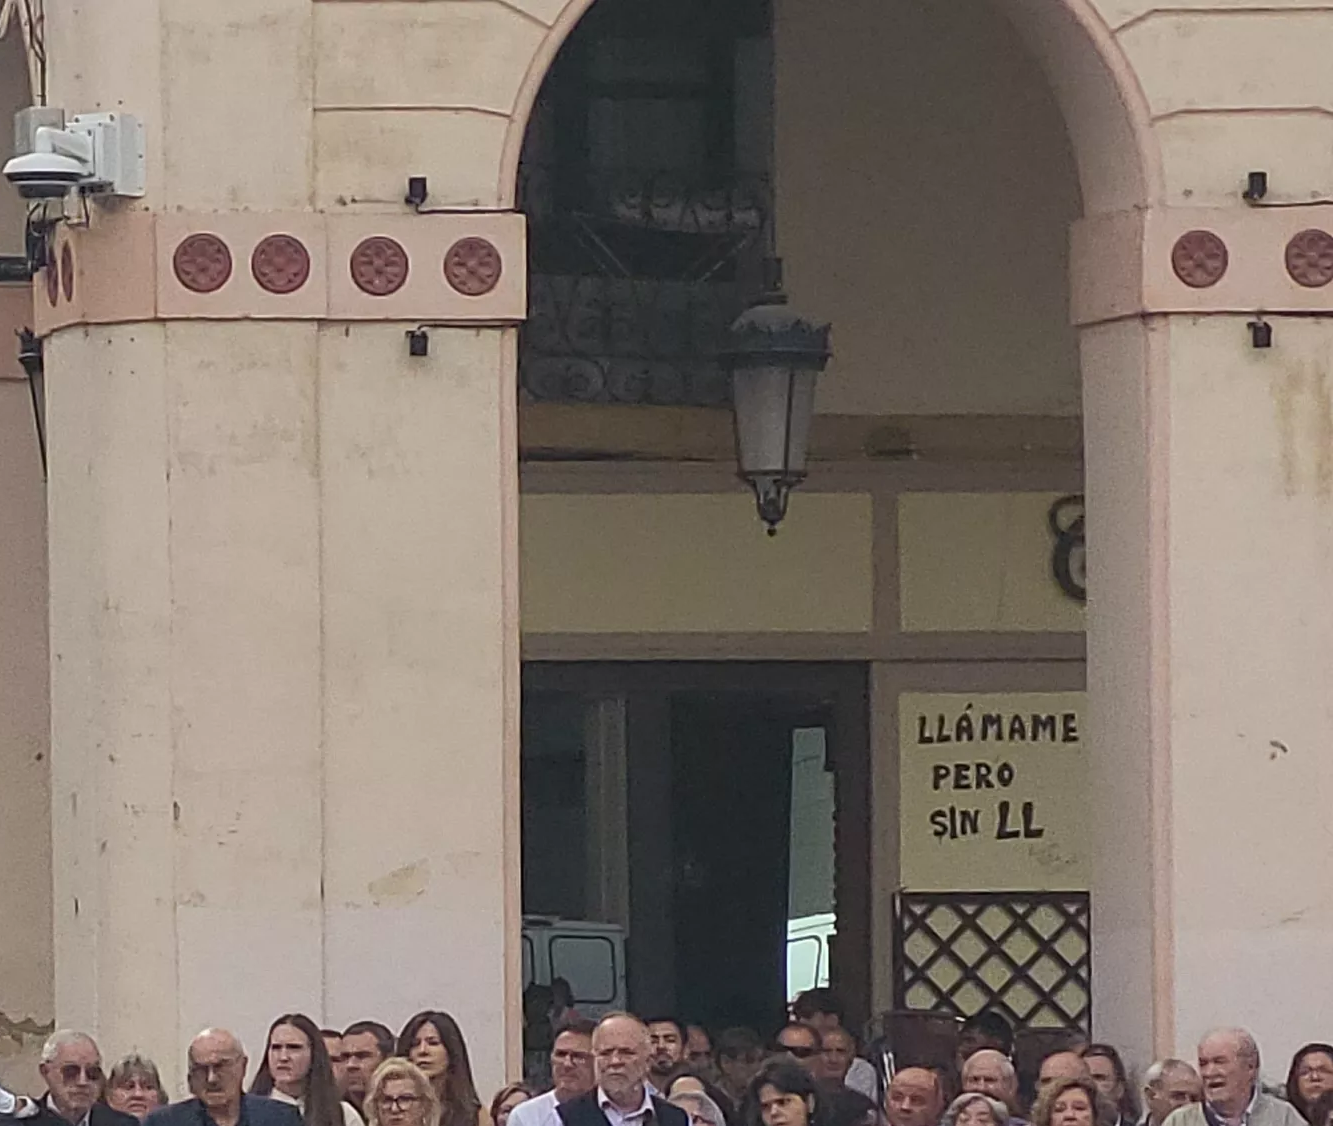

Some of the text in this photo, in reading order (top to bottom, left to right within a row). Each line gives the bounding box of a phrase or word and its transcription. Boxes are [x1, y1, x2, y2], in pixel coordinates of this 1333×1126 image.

[917, 702, 1080, 745] LLÁMAME
[932, 761, 1015, 791] PERO
[929, 800, 1045, 840] SIN LL
